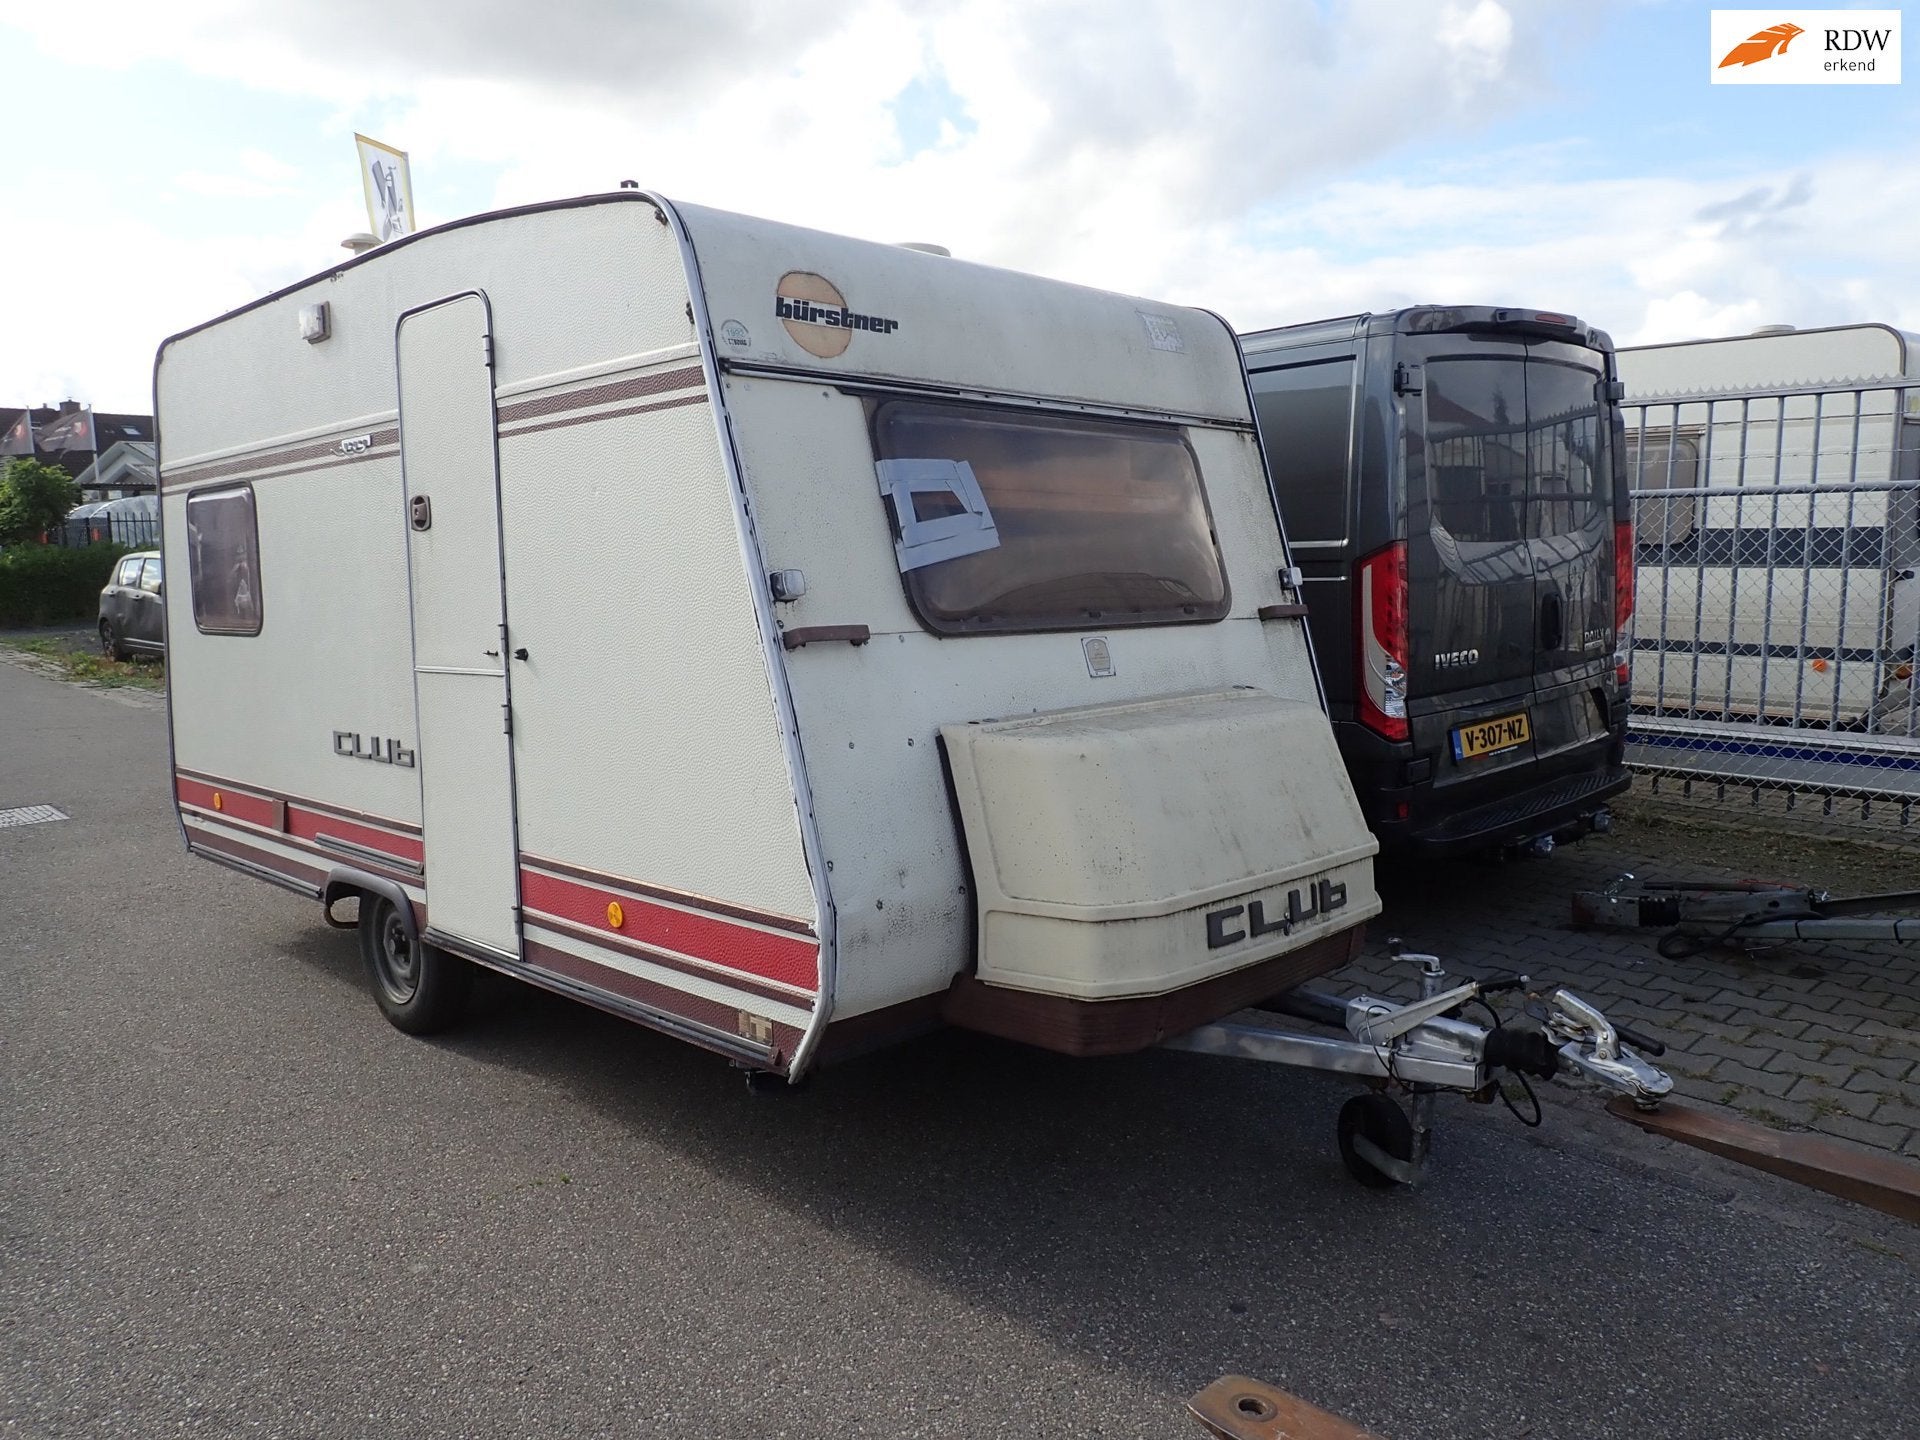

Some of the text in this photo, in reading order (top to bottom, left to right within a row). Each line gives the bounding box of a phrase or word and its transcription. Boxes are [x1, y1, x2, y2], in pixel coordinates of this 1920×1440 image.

[775, 296, 899, 334] bürstner
[1434, 649, 1479, 670] IVECO
[1465, 718, 1525, 752] V-307-NZ
